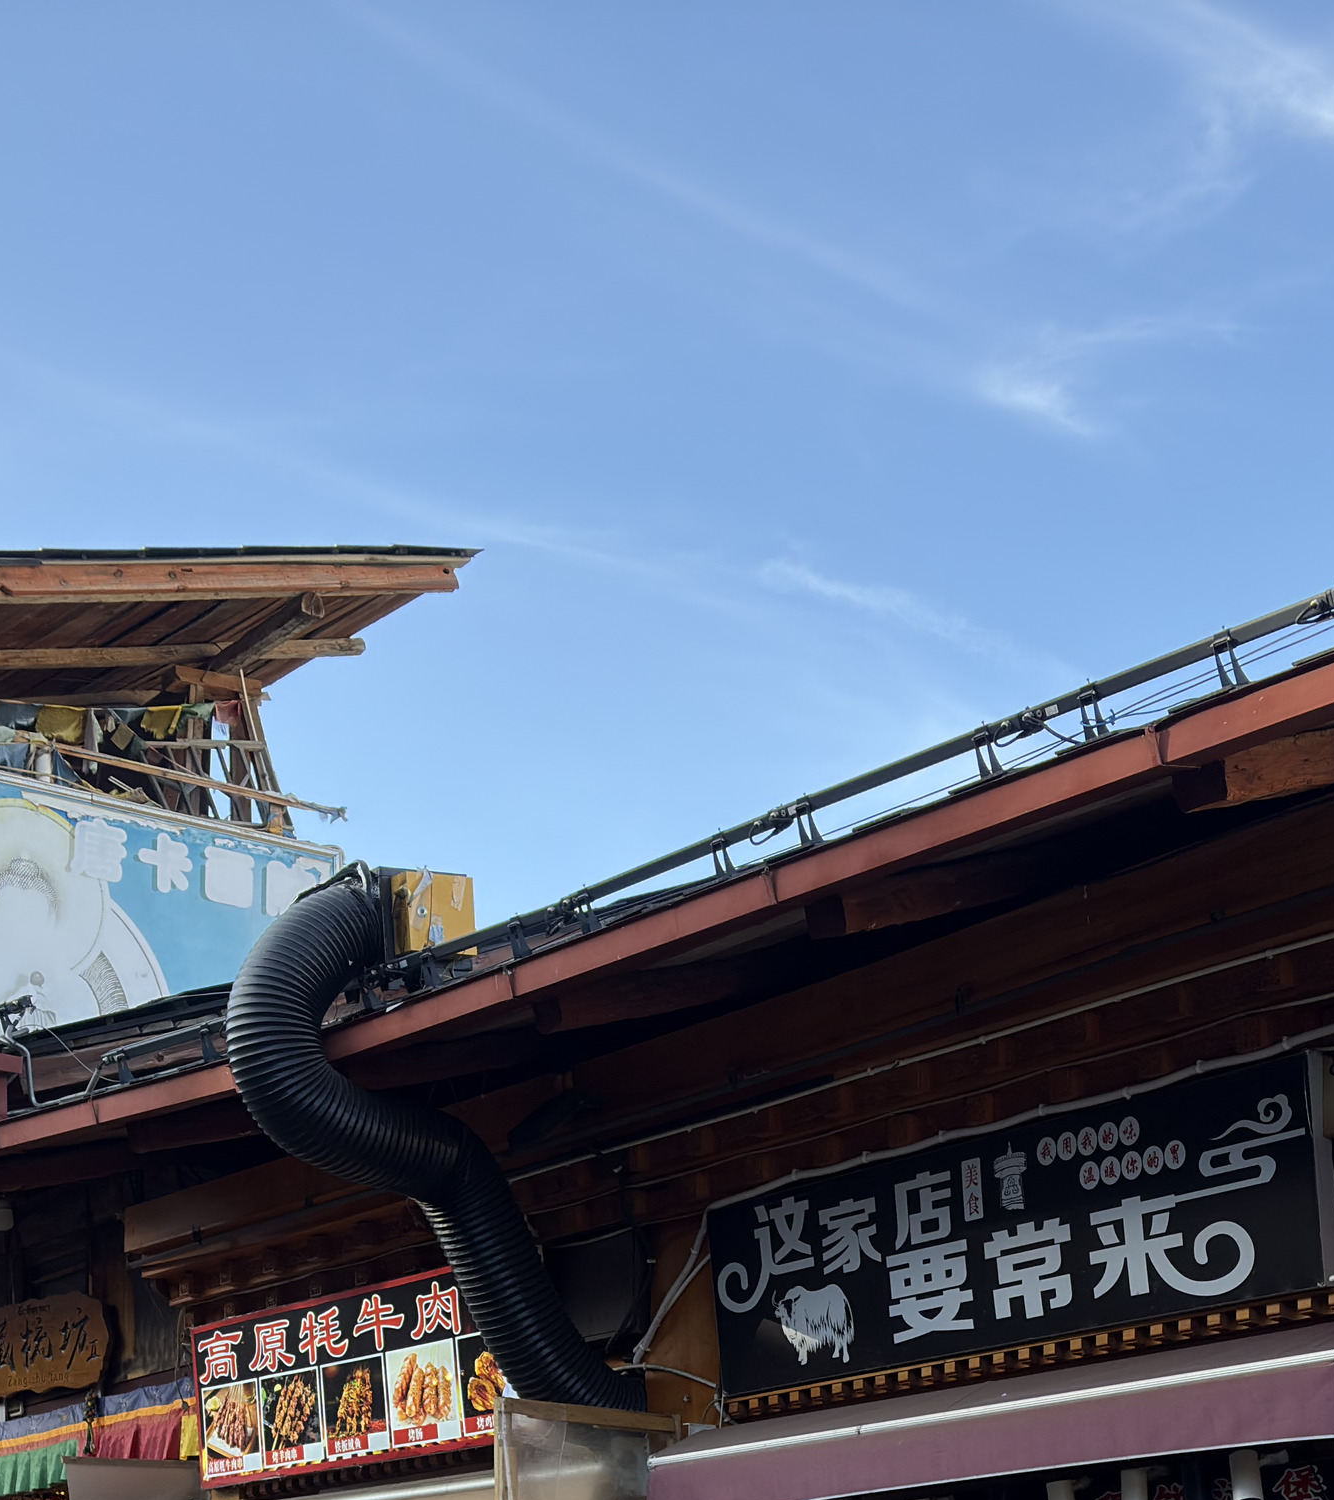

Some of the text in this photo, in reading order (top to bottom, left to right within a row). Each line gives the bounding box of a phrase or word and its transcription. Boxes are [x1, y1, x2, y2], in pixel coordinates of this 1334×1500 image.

[1038, 1119, 1138, 1163] 我用我的味
[1081, 1142, 1182, 1187] 温暖你的胃
[964, 1164, 980, 1217] 美食
[725, 1170, 953, 1302] 这家店
[885, 1188, 1255, 1345] 要常来
[198, 1281, 462, 1385] 高原牦牛肉
[476, 1416, 495, 1431] 烤鸡
[271, 1448, 298, 1463] 烤羊肉串
